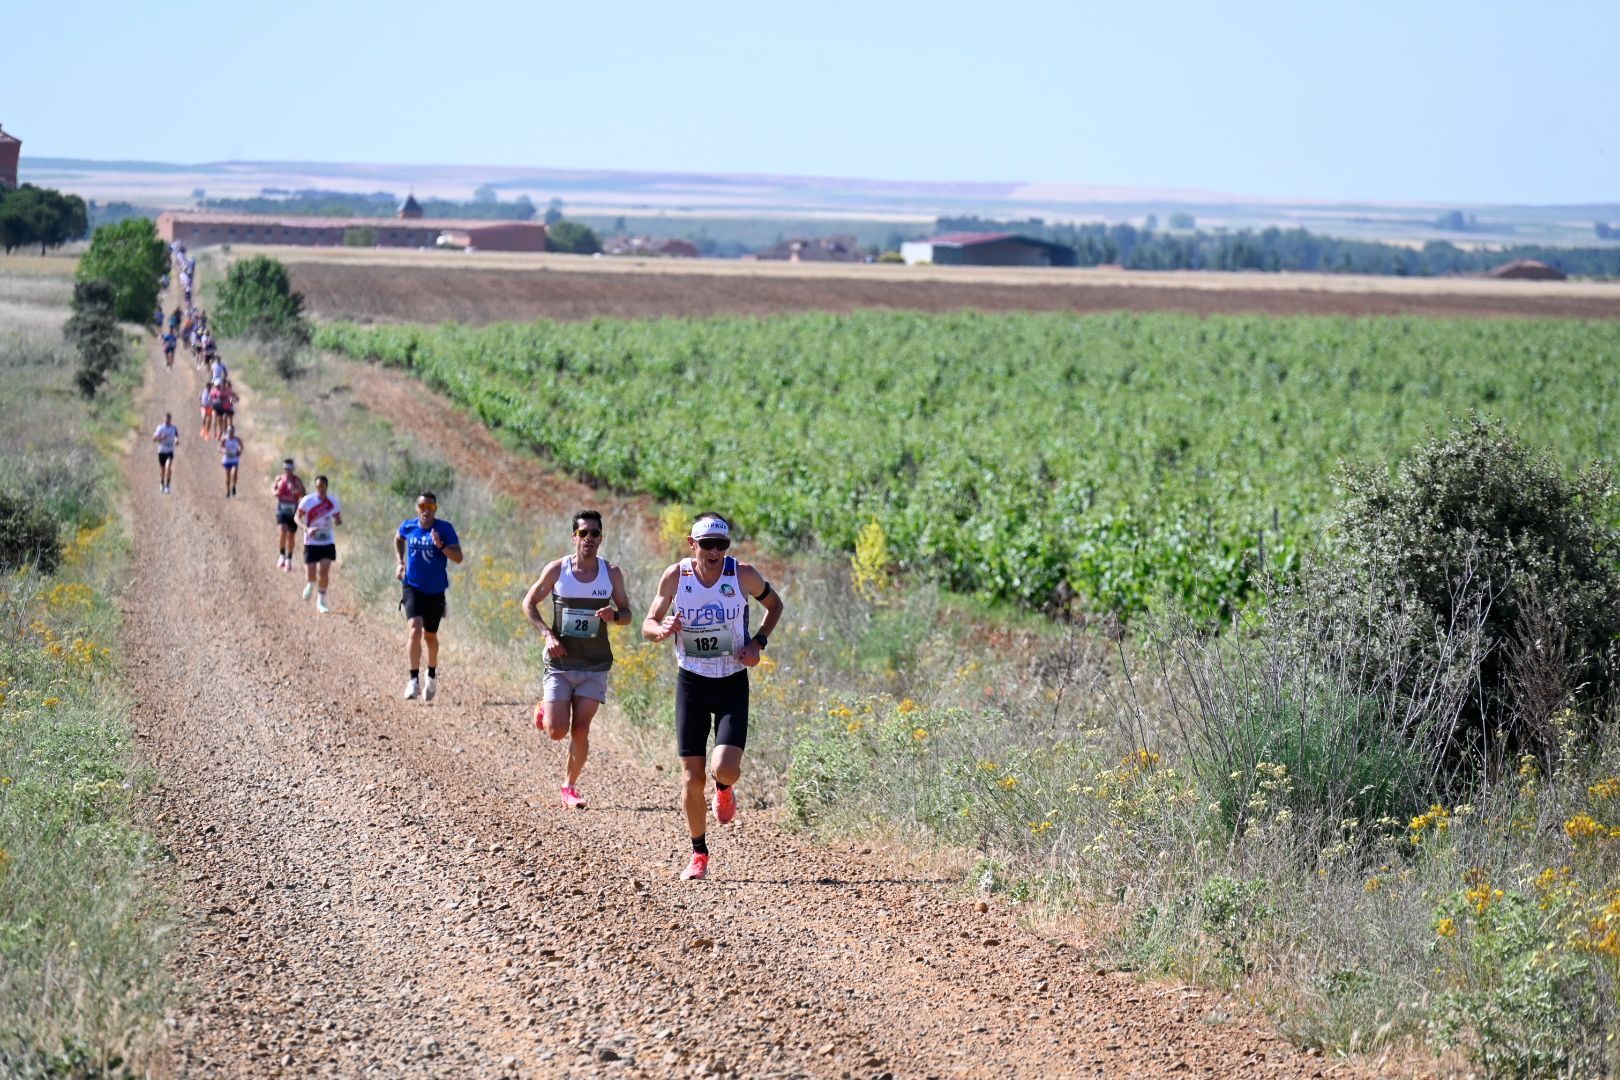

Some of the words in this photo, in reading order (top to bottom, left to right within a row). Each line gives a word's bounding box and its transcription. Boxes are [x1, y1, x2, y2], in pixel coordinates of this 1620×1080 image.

[679, 604, 740, 624] arregui
[574, 619, 589, 632] 28
[693, 636, 719, 652] 182
